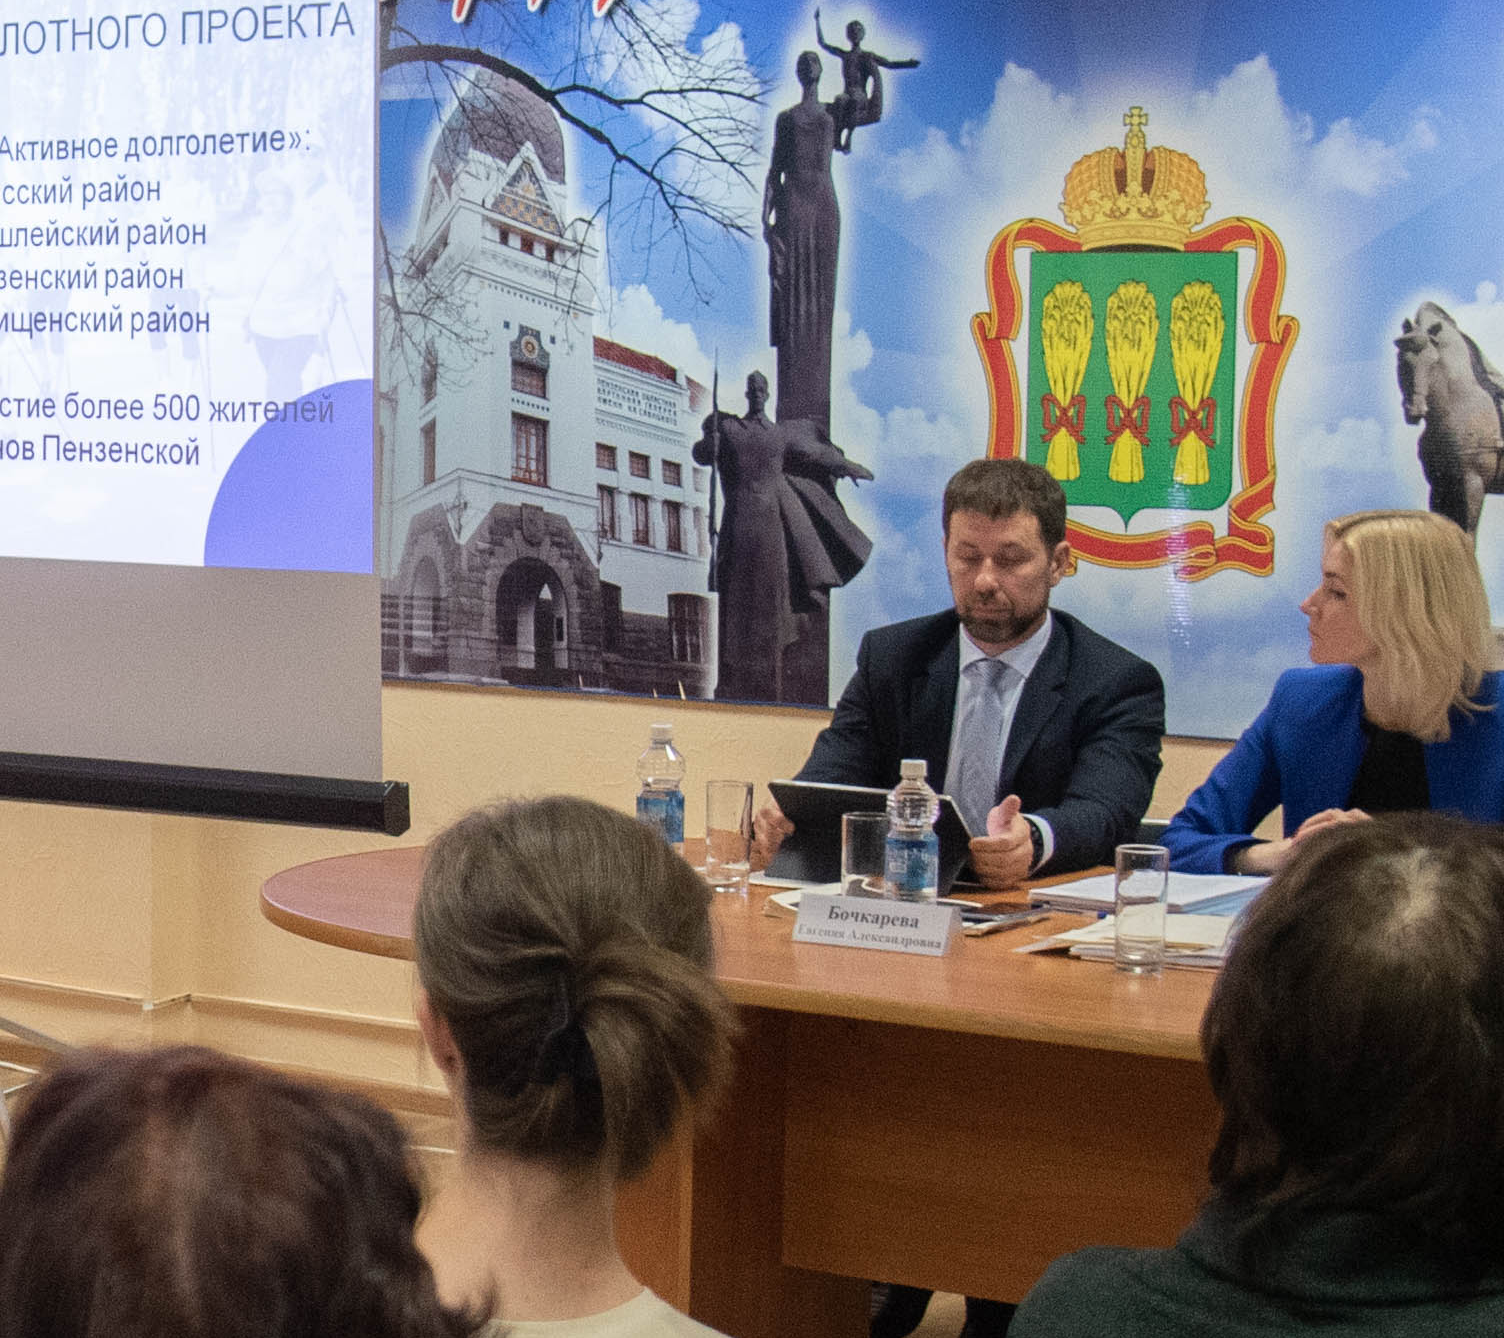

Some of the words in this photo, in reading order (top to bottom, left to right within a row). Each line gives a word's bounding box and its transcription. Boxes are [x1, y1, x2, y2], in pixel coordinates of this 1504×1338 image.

[181, 1, 355, 45] ПРОЕКТА
[124, 128, 311, 162] долголетие»:
[82, 173, 162, 211] район
[126, 216, 207, 253] район
[104, 261, 184, 296] район
[130, 304, 211, 340] район
[64, 391, 144, 420] более
[152, 393, 201, 421] 500
[208, 392, 335, 423] жителей
[42, 434, 200, 466] Пензенской
[828, 905, 919, 929] Бочкарева
[798, 924, 845, 940] Евгения
[850, 930, 941, 949] Александровна
